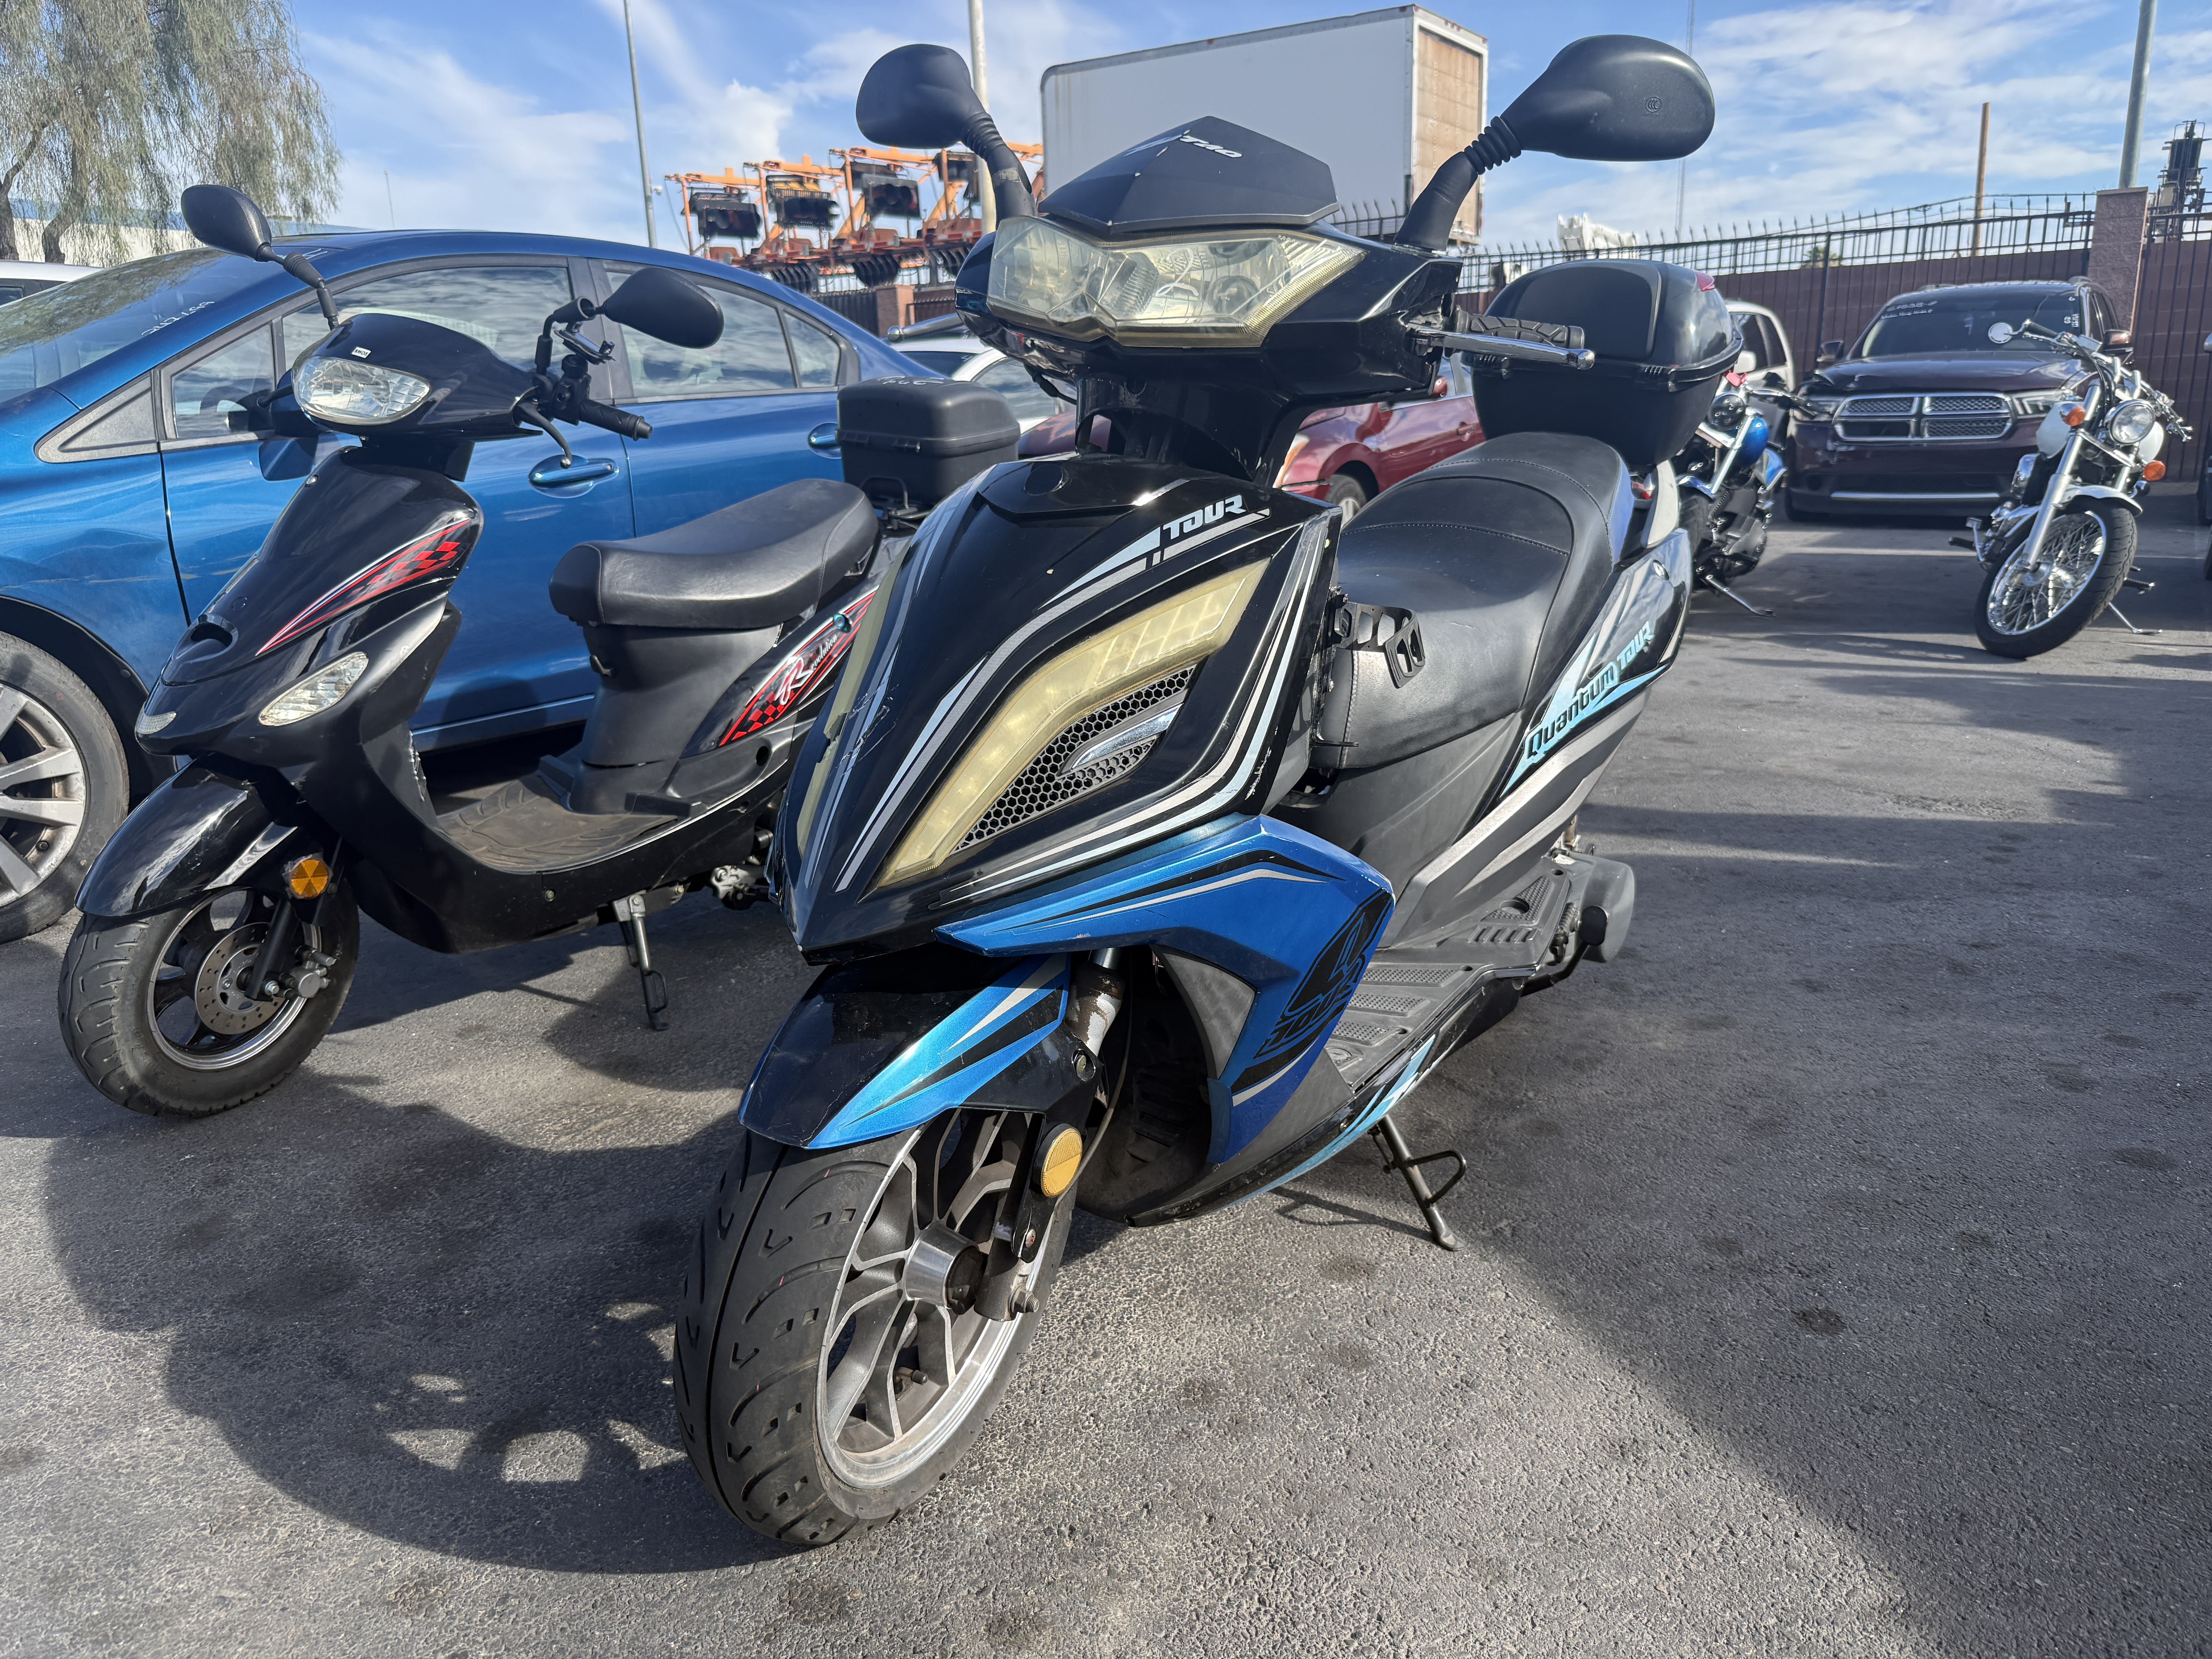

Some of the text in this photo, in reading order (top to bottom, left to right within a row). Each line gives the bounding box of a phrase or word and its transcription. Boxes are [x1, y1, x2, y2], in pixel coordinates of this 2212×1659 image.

[1155, 248, 1199, 297] 2
[1163, 495, 1246, 540] TOUR
[1527, 620, 1655, 759] Quantum TOUR
